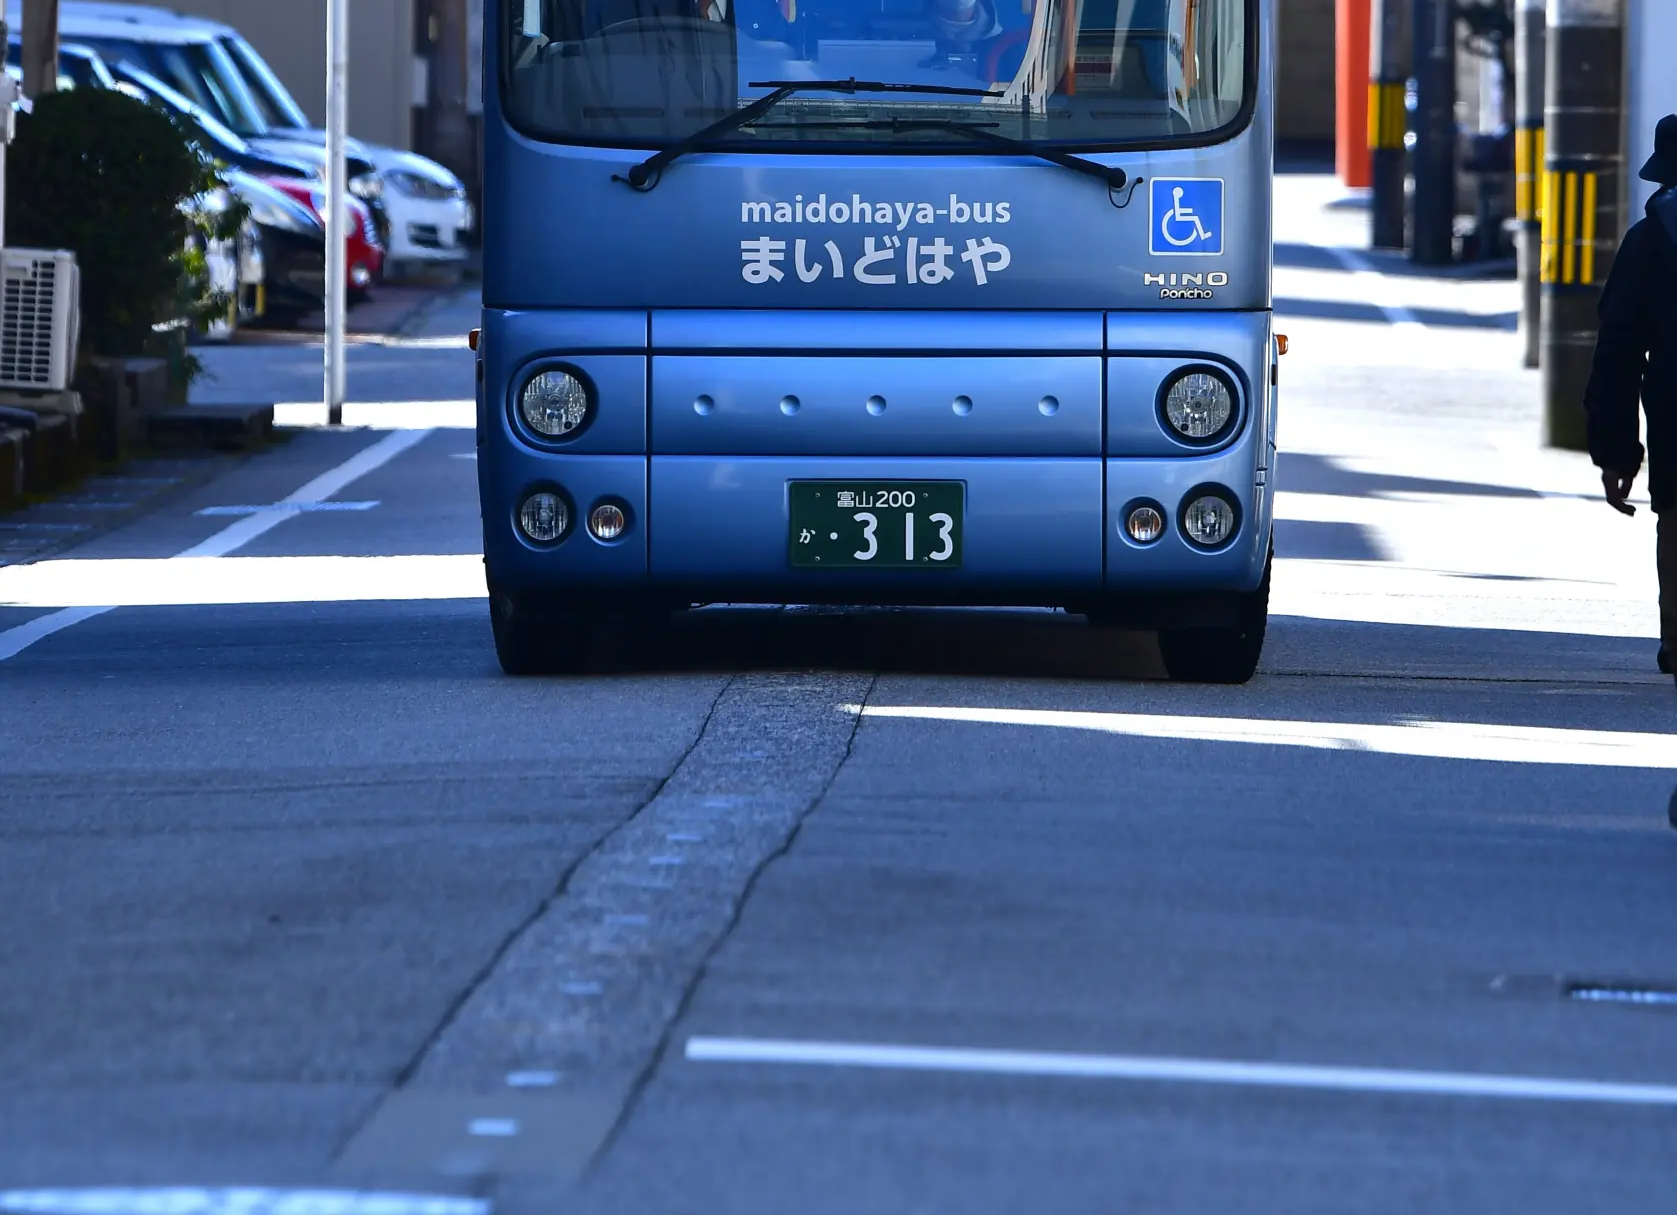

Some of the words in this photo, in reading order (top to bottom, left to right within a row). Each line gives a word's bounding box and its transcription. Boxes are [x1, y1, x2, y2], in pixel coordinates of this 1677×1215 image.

[740, 193, 1012, 231] maidohaya-bus
[740, 235, 1012, 286] まいどはや
[1143, 271, 1229, 287] HINO
[799, 528, 816, 544] か
